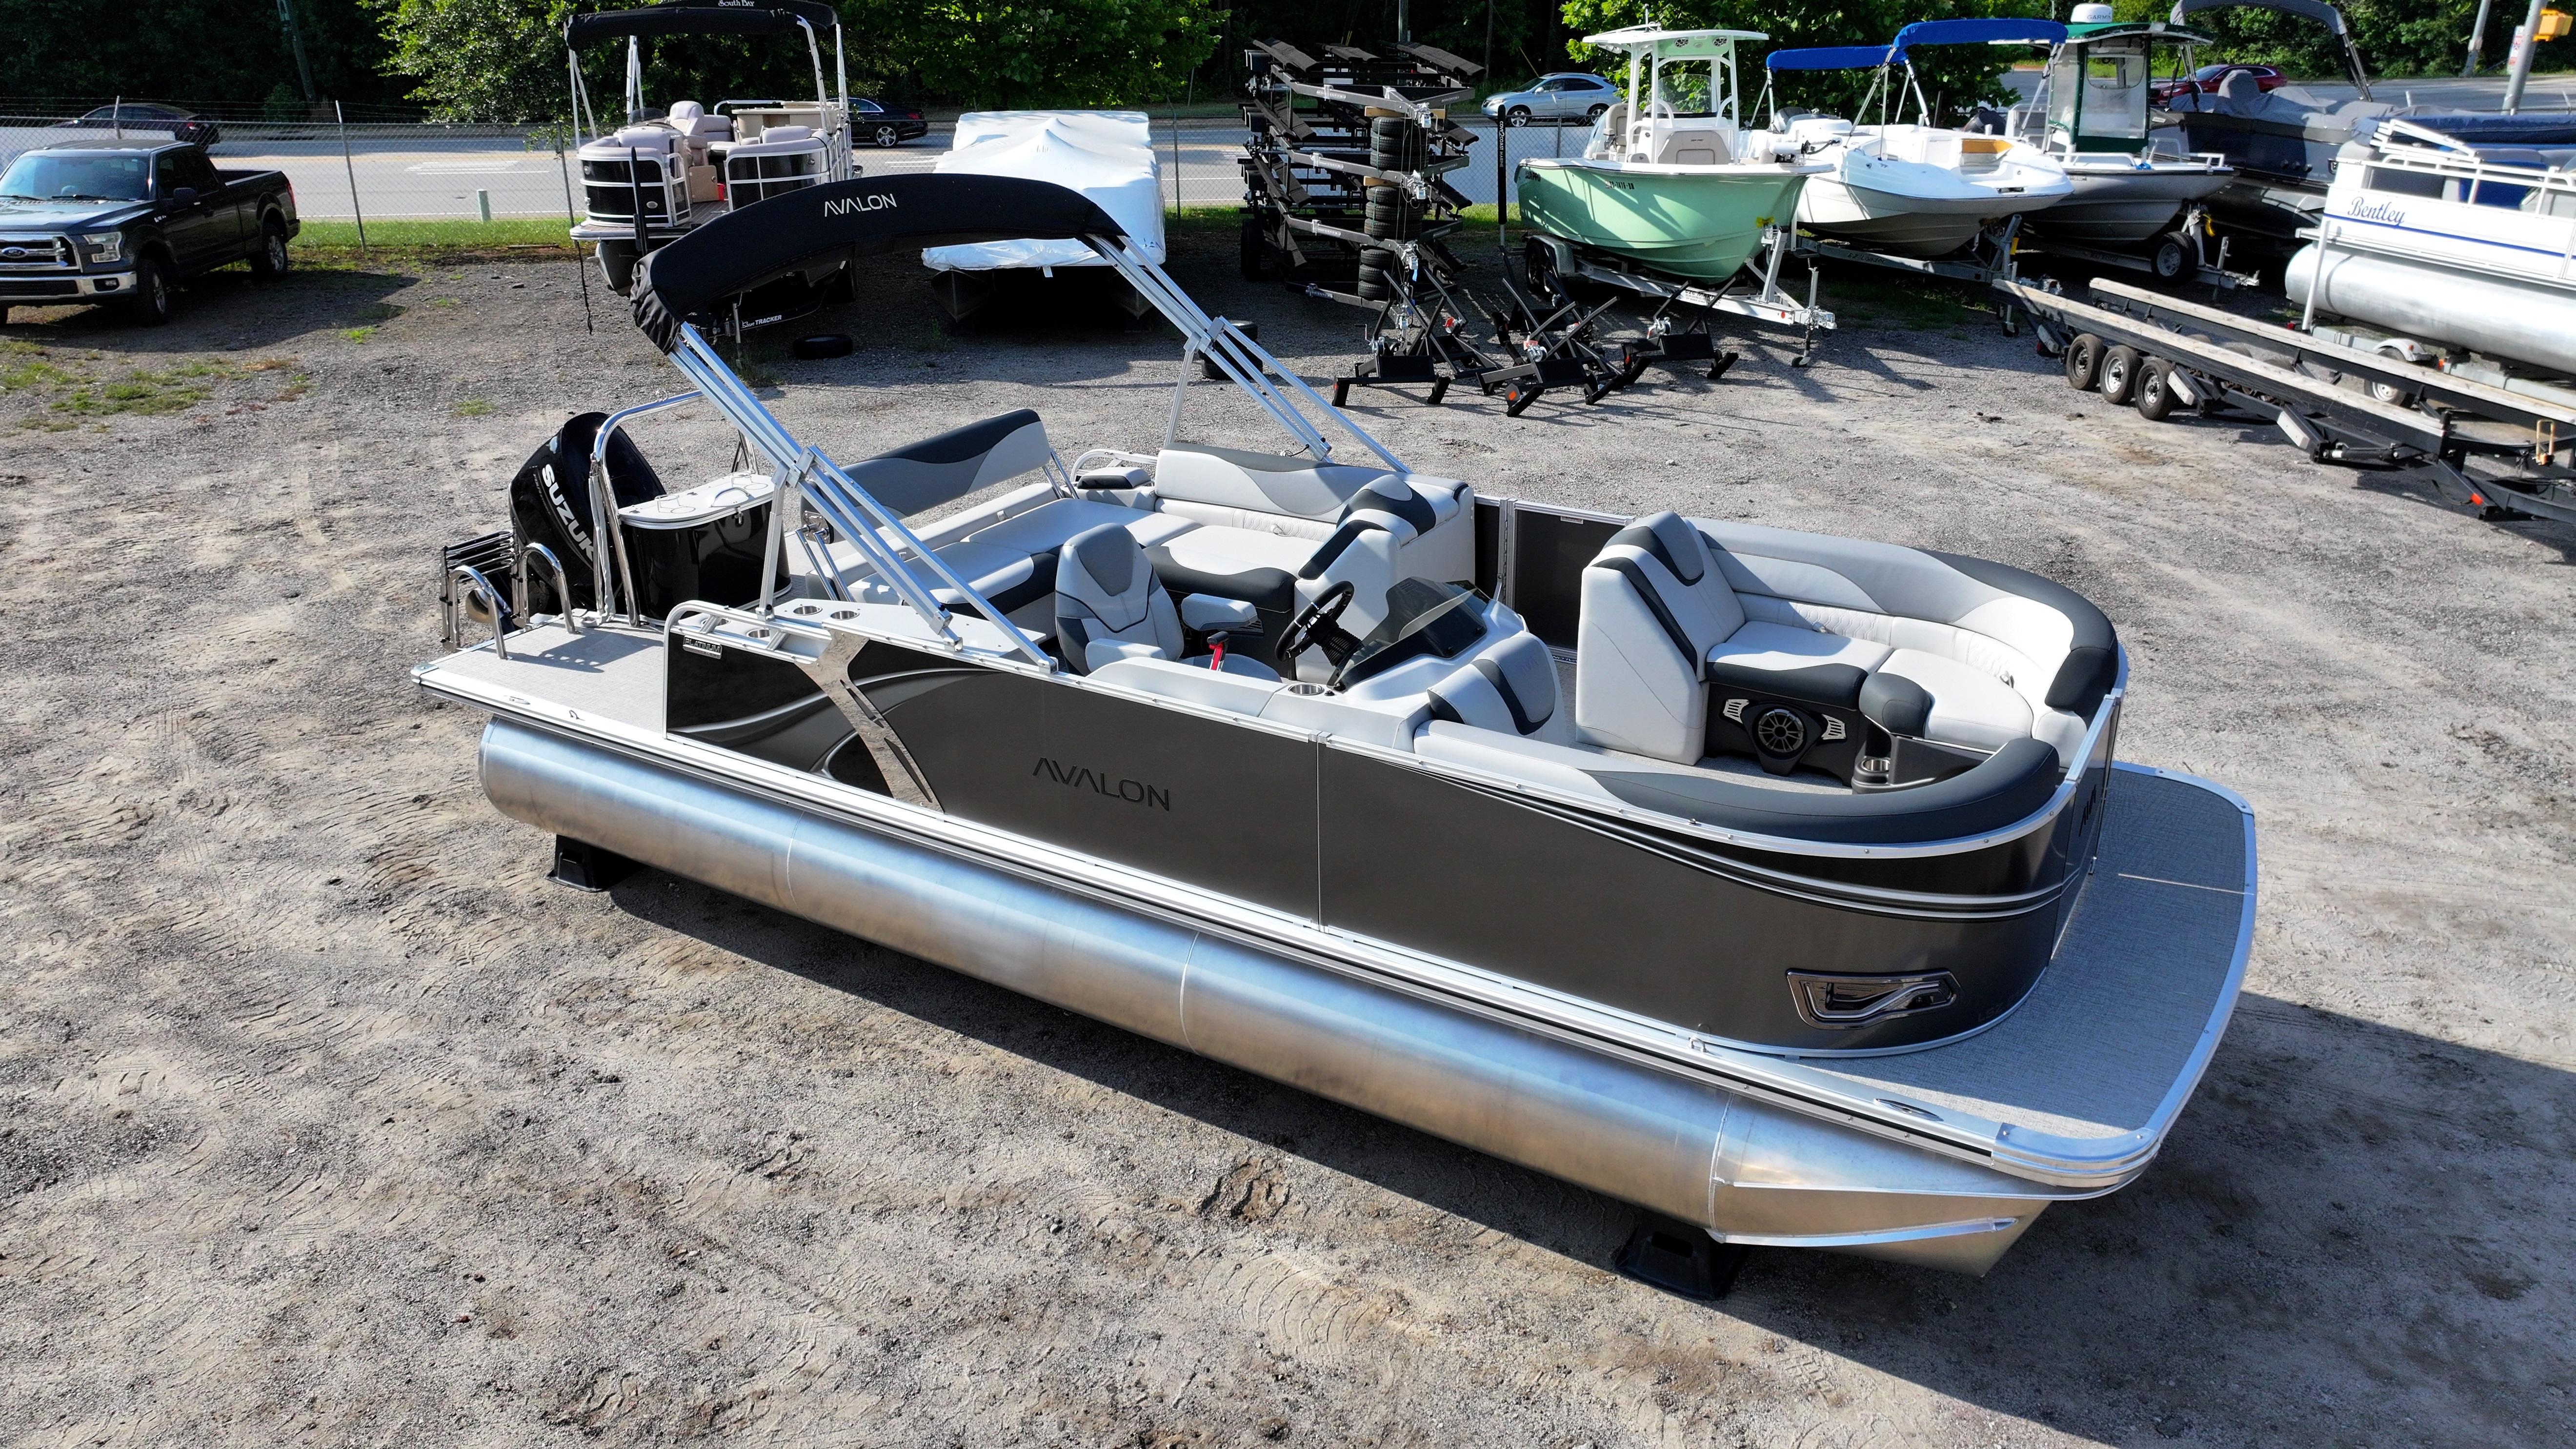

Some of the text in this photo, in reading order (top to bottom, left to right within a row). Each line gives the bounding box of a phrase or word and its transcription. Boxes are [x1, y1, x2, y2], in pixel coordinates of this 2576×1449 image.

[825, 193, 897, 217] AVALON
[2347, 197, 2405, 229] Bentley
[755, 315, 782, 325] TRACKER
[542, 464, 594, 562] SUZUK
[684, 638, 720, 653] PLATINUM
[1032, 757, 1169, 811] AVALON
